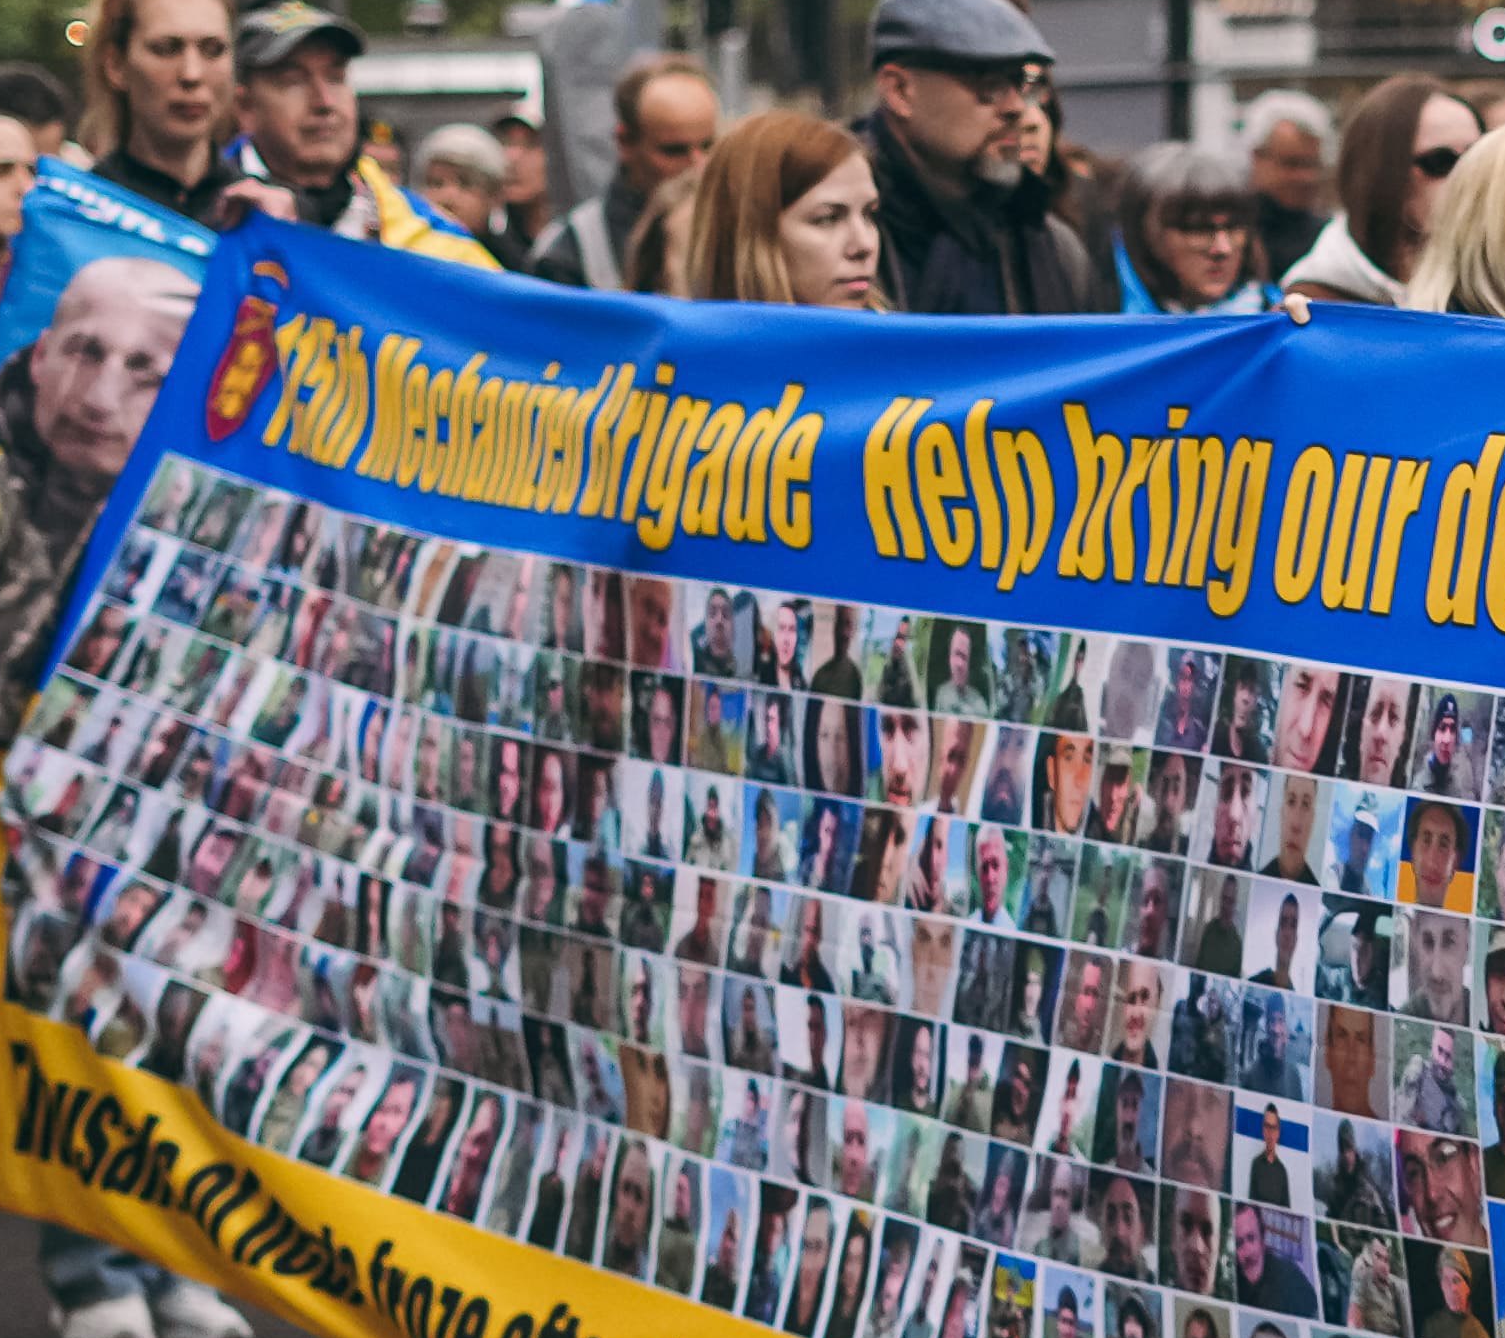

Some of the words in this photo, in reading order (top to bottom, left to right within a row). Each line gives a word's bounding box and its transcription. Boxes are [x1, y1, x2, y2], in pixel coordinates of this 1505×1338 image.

[355, 334, 616, 515] Mechanized
[862, 396, 1056, 591] Help
[1058, 404, 1273, 618] bring
[1275, 443, 1428, 617] our
